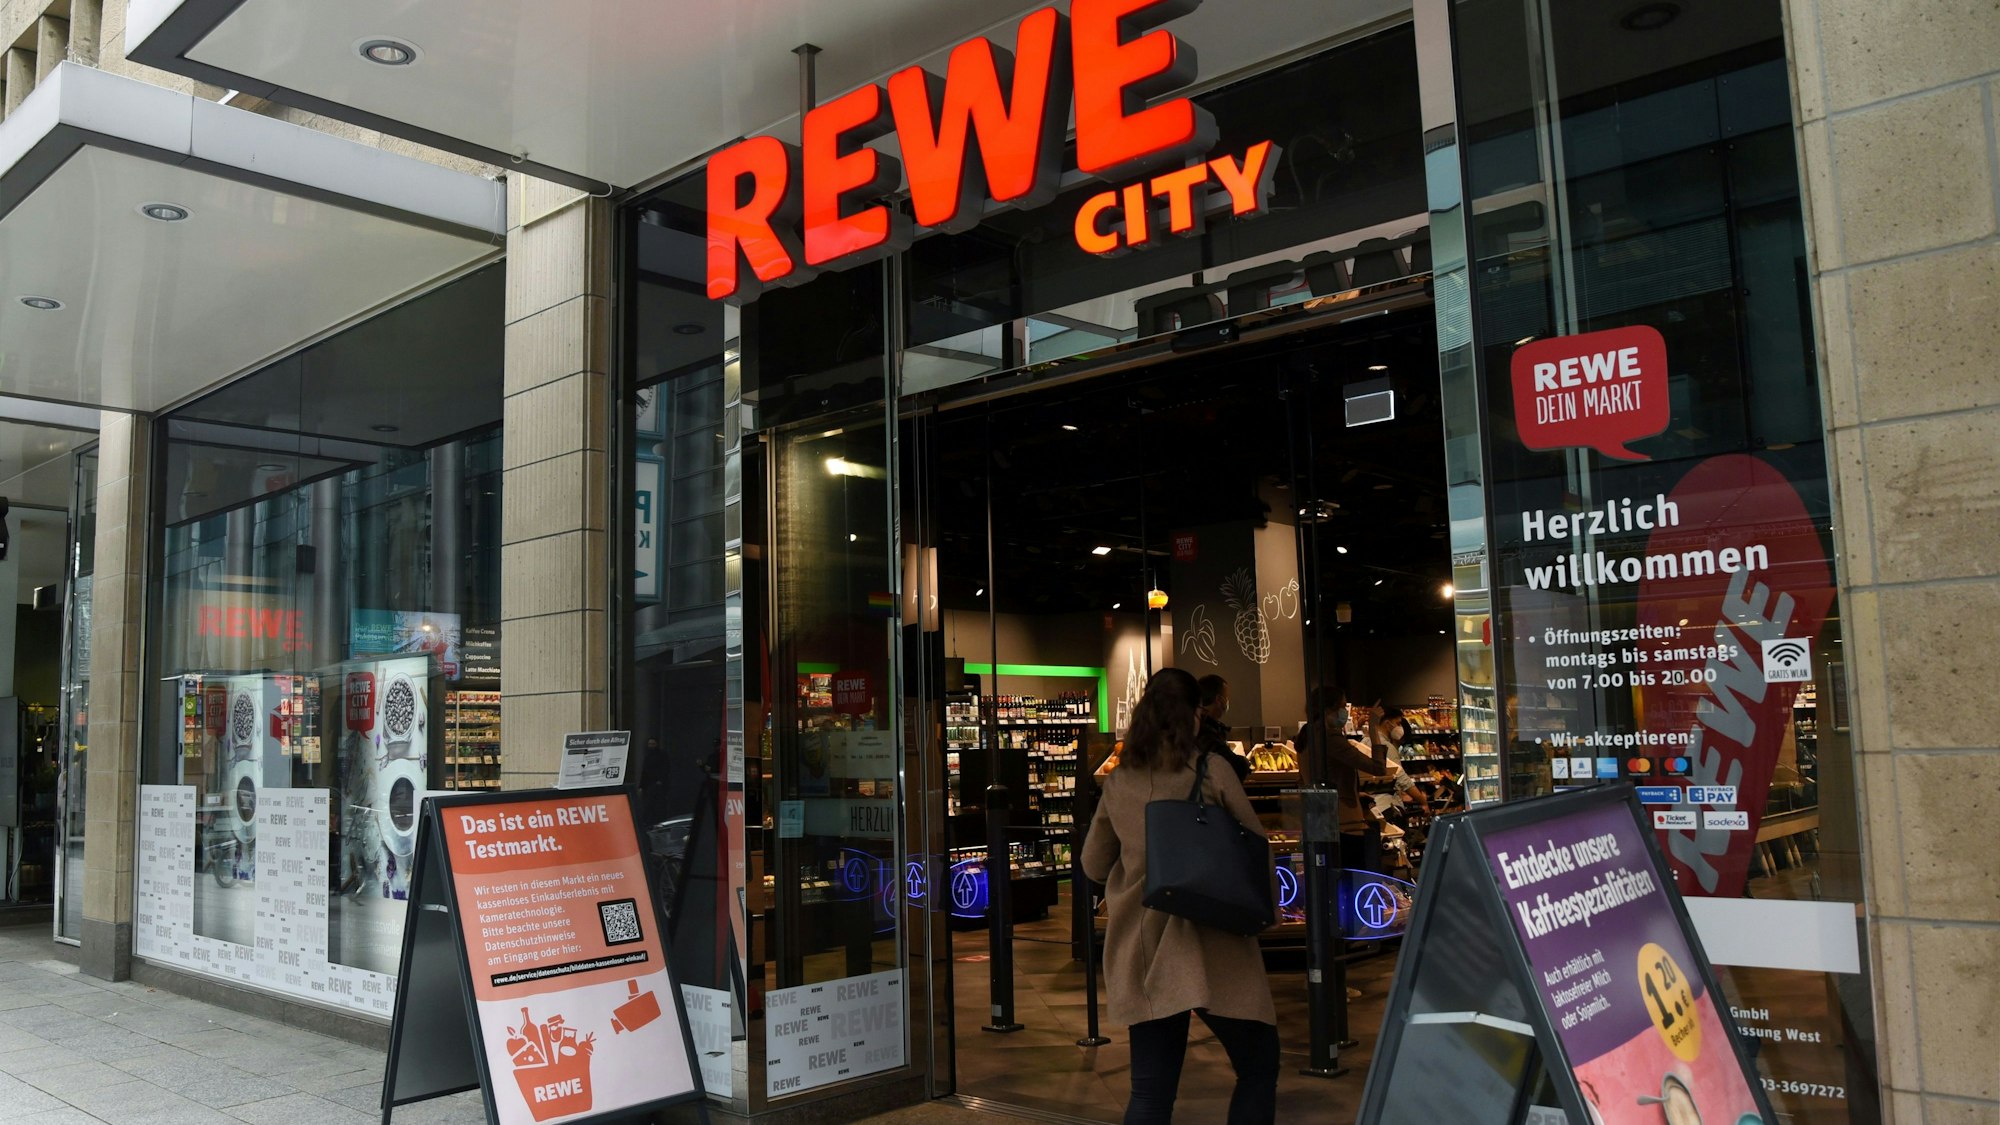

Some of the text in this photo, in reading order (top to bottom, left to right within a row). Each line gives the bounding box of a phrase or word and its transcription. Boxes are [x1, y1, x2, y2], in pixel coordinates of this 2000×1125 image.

[706, 0, 1196, 300] REWE
[1075, 140, 1274, 255] CITY
[1534, 346, 1641, 392] REWE
[1536, 380, 1642, 425] DEIN MARKT
[1522, 494, 1679, 541] Herzlich
[1524, 543, 1769, 590] willkommen
[199, 605, 304, 639] REWE
[1544, 625, 1681, 646] Öffnungszeiten:
[465, 653, 491, 661] Cappuccino
[1545, 642, 1738, 669] montags bis samstags
[1547, 668, 1717, 690] von 7.00 bis 20.00
[1768, 669, 1808, 679] GRATIS WLAN
[350, 681, 370, 693] REWE
[837, 679, 865, 691] REWE
[352, 694, 368, 707] CITY
[569, 738, 585, 746] Sicher
[611, 736, 626, 744] Alltag
[1550, 731, 1695, 749] Wir akzeptieren:
[286, 796, 304, 808] REWE
[1707, 793, 1734, 803] PAY
[270, 814, 287, 826] REWE
[460, 804, 609, 835] Das ist ein REWE
[851, 806, 894, 832] HERZLI
[1707, 815, 1746, 827] sodexo
[275, 837, 291, 848] REWE
[465, 834, 562, 860] Testmarkt.
[257, 851, 276, 864] REWE
[281, 859, 303, 874] REWE
[1497, 833, 1621, 889] Entdecke unsere
[474, 871, 624, 896] Wir testen in diesem Markt ein neues
[306, 892, 326, 907] REWE
[477, 885, 615, 910] kassenloses Einkaufserlebnis mit
[1516, 867, 1656, 940] Kaffeespezialitäten
[274, 899, 296, 915] REWE
[479, 905, 566, 924] Kameratechnologie.
[155, 925, 172, 939] REWE
[482, 917, 571, 938] Bitte beachte unsere
[256, 936, 274, 950] REWE
[485, 930, 576, 952] Datenschutzhinweise
[193, 947, 211, 962] REWE
[217, 949, 231, 961] REWE
[234, 946, 254, 962] REWE
[278, 950, 300, 967] REWE
[488, 944, 582, 966] am Eingang oder hier:
[1544, 948, 1605, 986] Auch erhältlich mit
[311, 981, 325, 992] REWE
[328, 976, 352, 995] REWE
[362, 980, 382, 994] REWE
[837, 980, 879, 1002] REWE
[1551, 970, 1612, 1008] laktosefreier Milch
[372, 999, 389, 1011] REWE
[684, 991, 712, 1012] EWE
[800, 1005, 822, 1017] REWE
[1561, 994, 1611, 1030] oder Sojamilch.
[1730, 1006, 1769, 1020] GmbH
[775, 1019, 809, 1037] REWE
[831, 1001, 898, 1040] REWE
[798, 1035, 820, 1047] REWE
[1786, 1028, 1821, 1043] West
[768, 1058, 781, 1066] REWE
[808, 1048, 847, 1070] REWE
[865, 1045, 899, 1064] REWE
[533, 1078, 583, 1103] REWE
[773, 1076, 801, 1092] REWE
